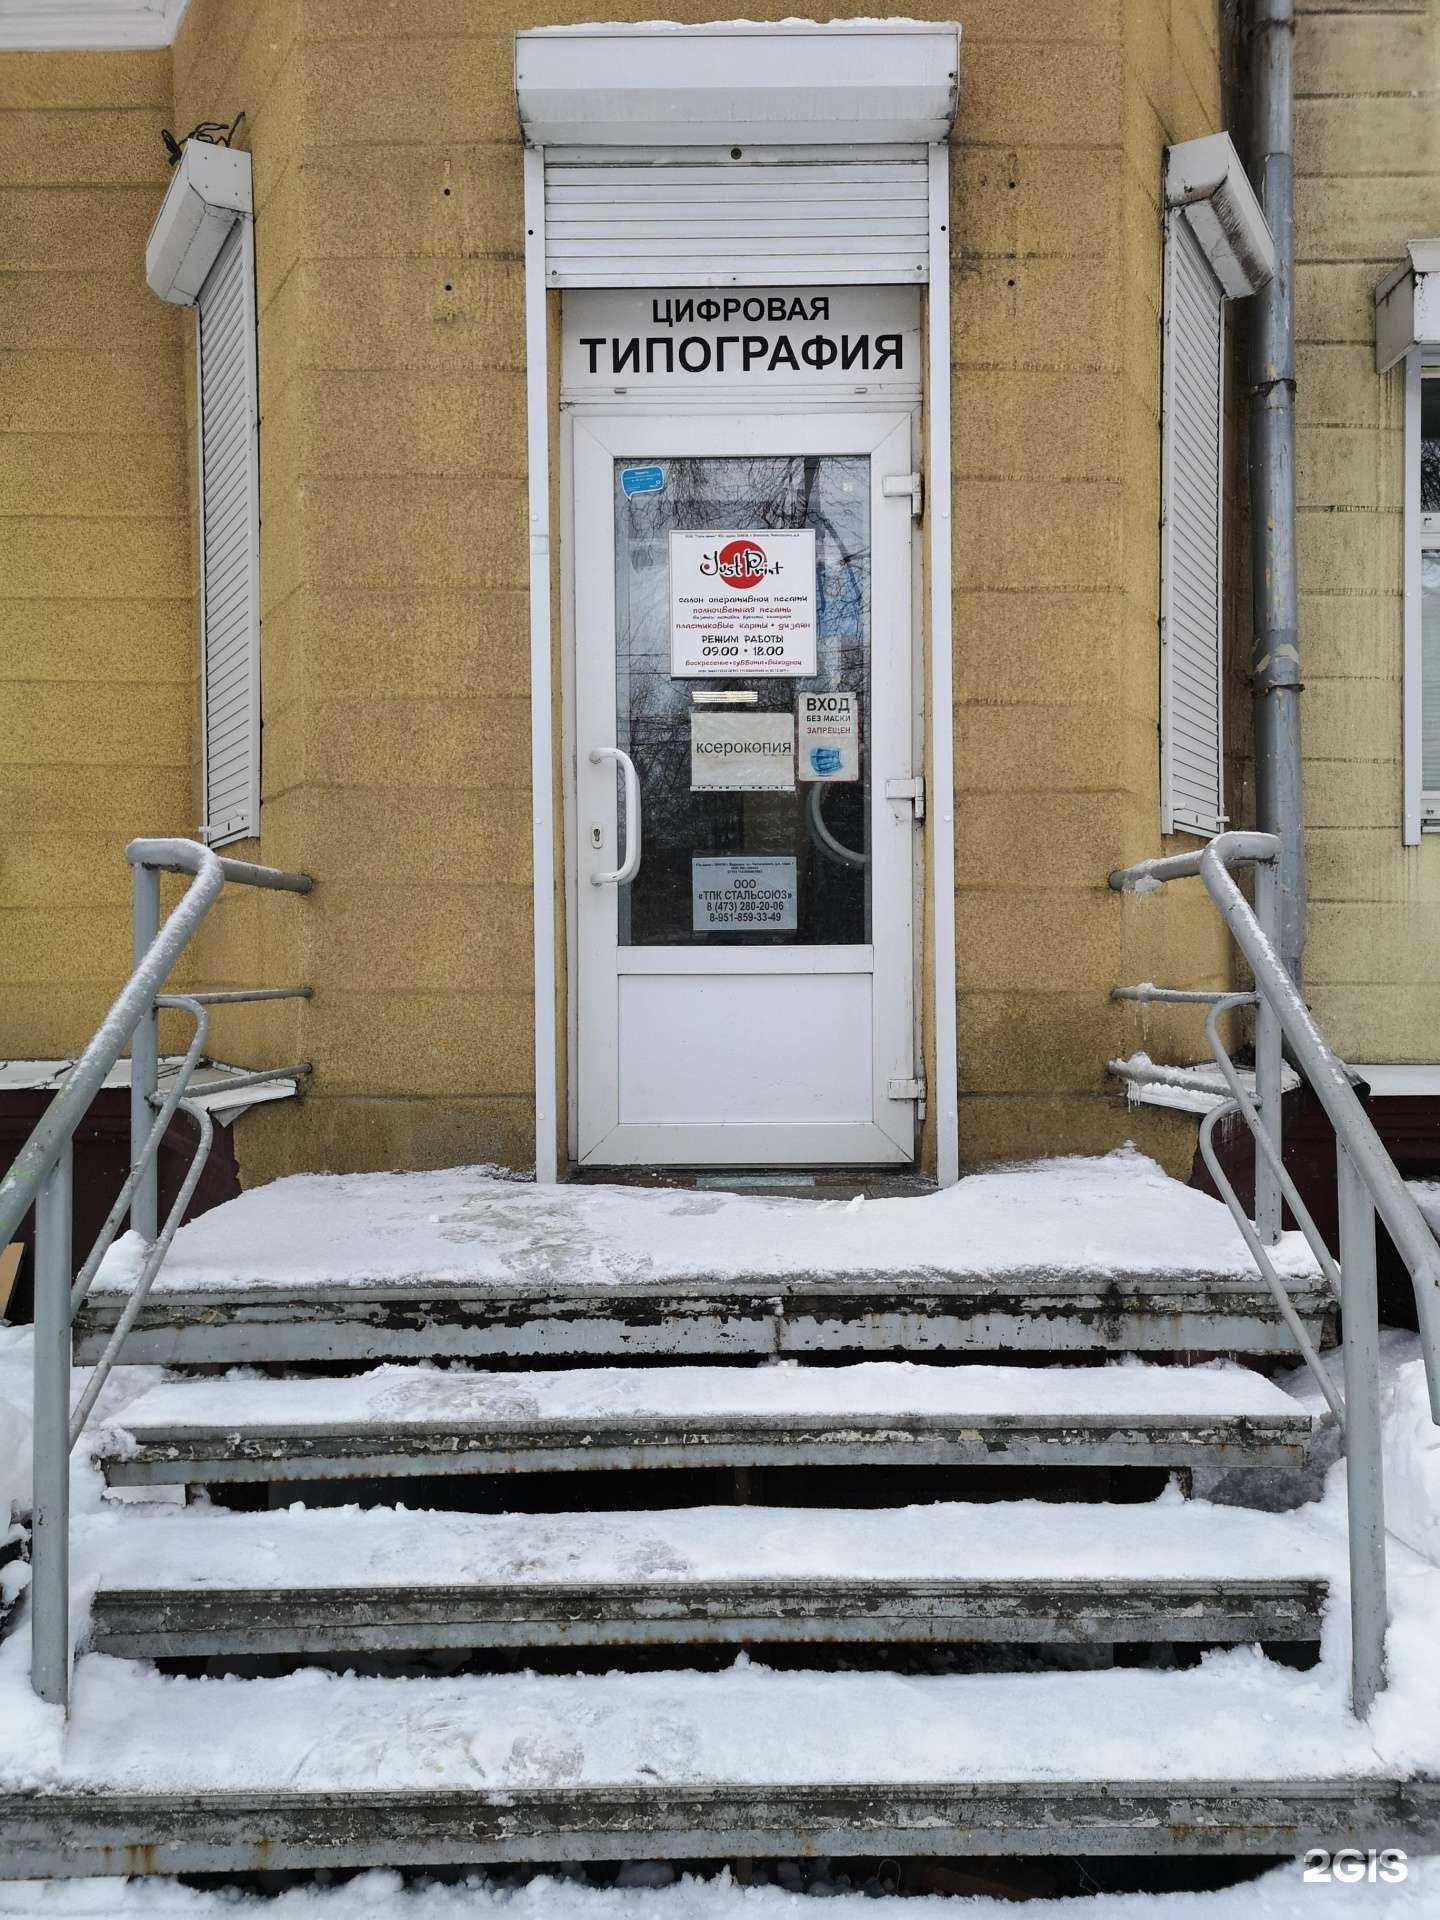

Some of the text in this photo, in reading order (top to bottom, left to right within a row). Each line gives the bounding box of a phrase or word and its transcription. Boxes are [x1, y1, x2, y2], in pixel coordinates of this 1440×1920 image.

[652, 296, 830, 327] ЦИФРОВАЯ
[579, 334, 904, 374] ТИПОГРАФИЯ
[699, 549, 784, 576] Just Print
[678, 596, 704, 604] салон
[708, 595, 770, 605] оперативной
[675, 621, 811, 631] пластиковые карты дизайн
[702, 634, 784, 643] РЕЖИМ РАБОТЫ
[702, 646, 784, 657] 09.00 18.00
[806, 697, 851, 713] ВХОД
[806, 726, 851, 735] ЗАПРЕЩЕН
[696, 741, 792, 757] ксерокопия
[733, 879, 757, 889] ООО
[698, 889, 792, 900] «ТПК СТАЛЬСОЮЗ»
[706, 901, 784, 913] 8 (473) 280-20-06
[709, 912, 781, 922] 8-951-859-33-49
